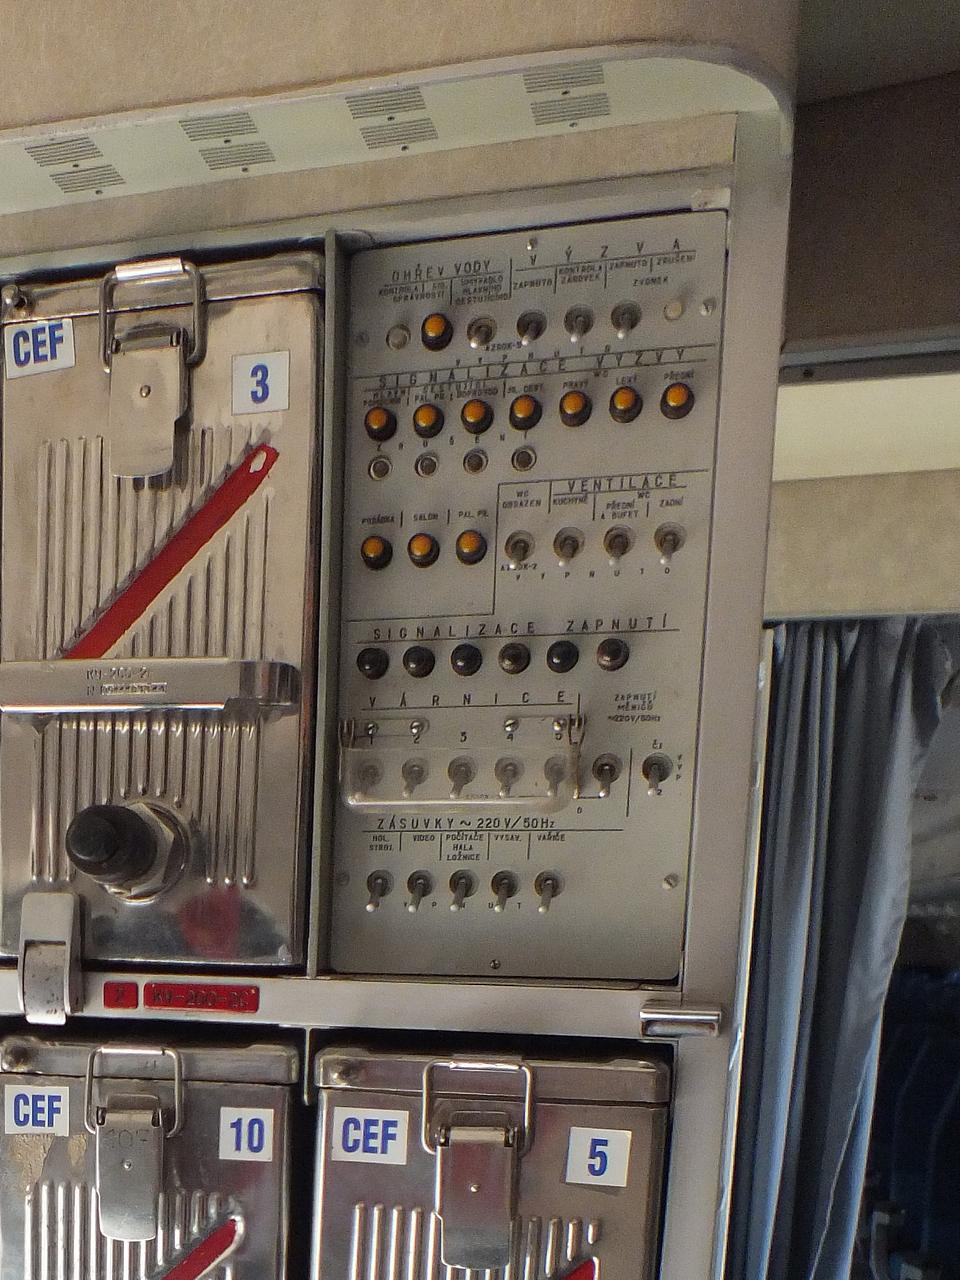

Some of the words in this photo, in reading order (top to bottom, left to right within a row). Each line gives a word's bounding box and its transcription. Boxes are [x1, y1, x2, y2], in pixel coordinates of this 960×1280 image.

[392, 264, 444, 281] OHŘEV
[454, 260, 490, 275] VODY
[12, 324, 65, 368] CEF
[250, 364, 270, 404] 3
[379, 360, 566, 387] SIGNALIZACE
[516, 490, 528, 498] WC
[568, 475, 678, 493] VENTILACE
[374, 622, 535, 639] SIGNALIZACE
[566, 613, 667, 632] ZAPNUTÍ
[369, 691, 565, 707] VÁRNICE
[413, 735, 420, 744] 2
[460, 732, 467, 742] 3
[378, 815, 454, 829] ZÁSUVKY
[453, 844, 473, 852] HALA
[14, 1094, 63, 1128] CEF
[229, 1118, 265, 1153] 10
[341, 1117, 398, 1154] CEF
[588, 1138, 608, 1177] 5
